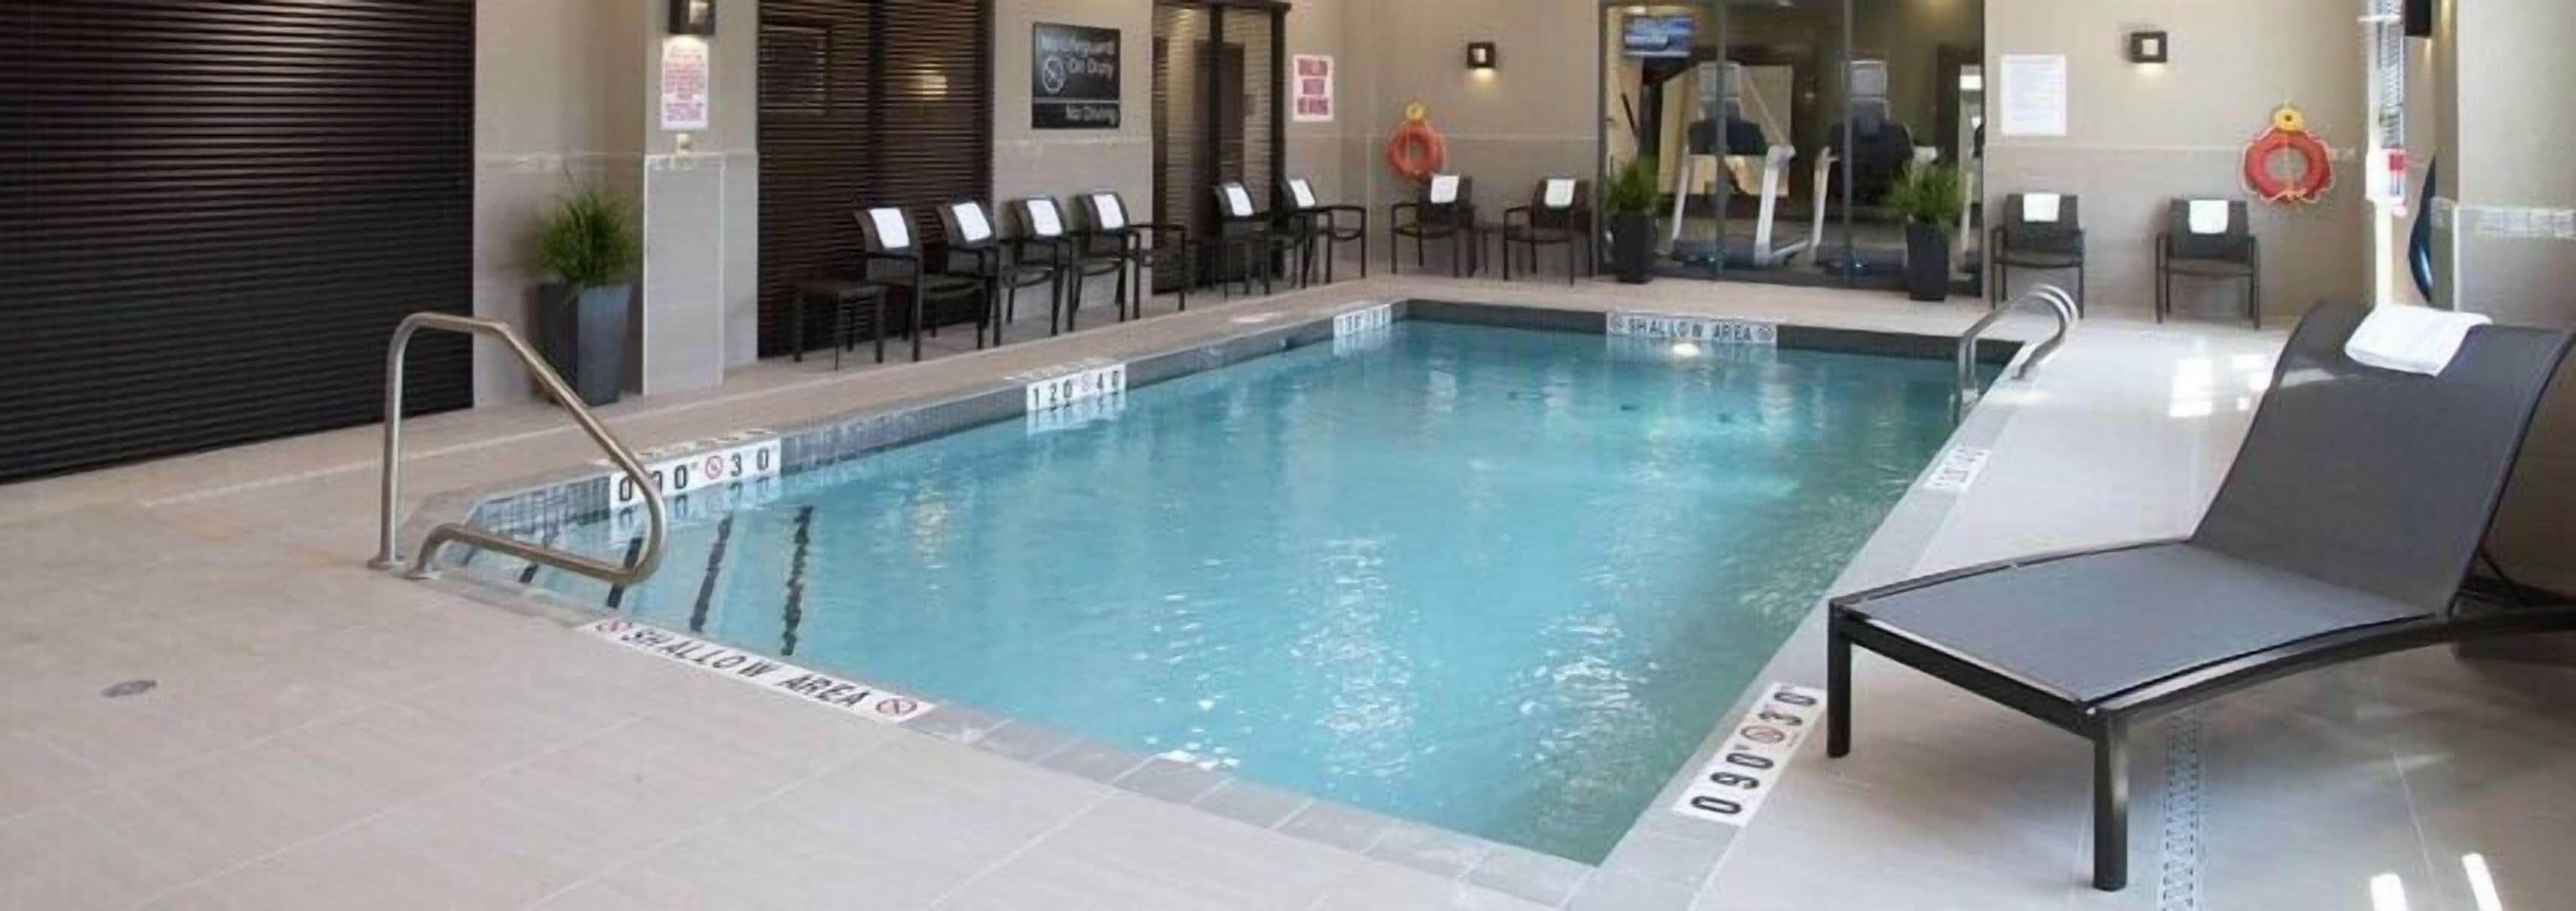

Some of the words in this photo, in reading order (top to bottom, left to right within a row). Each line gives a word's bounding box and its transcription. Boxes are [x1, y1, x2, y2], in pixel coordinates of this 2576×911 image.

[1628, 317, 1703, 339] SHALLOW
[1713, 321, 1752, 340] AREA
[620, 631, 782, 677] SHALLOW
[778, 673, 870, 708] AREA
